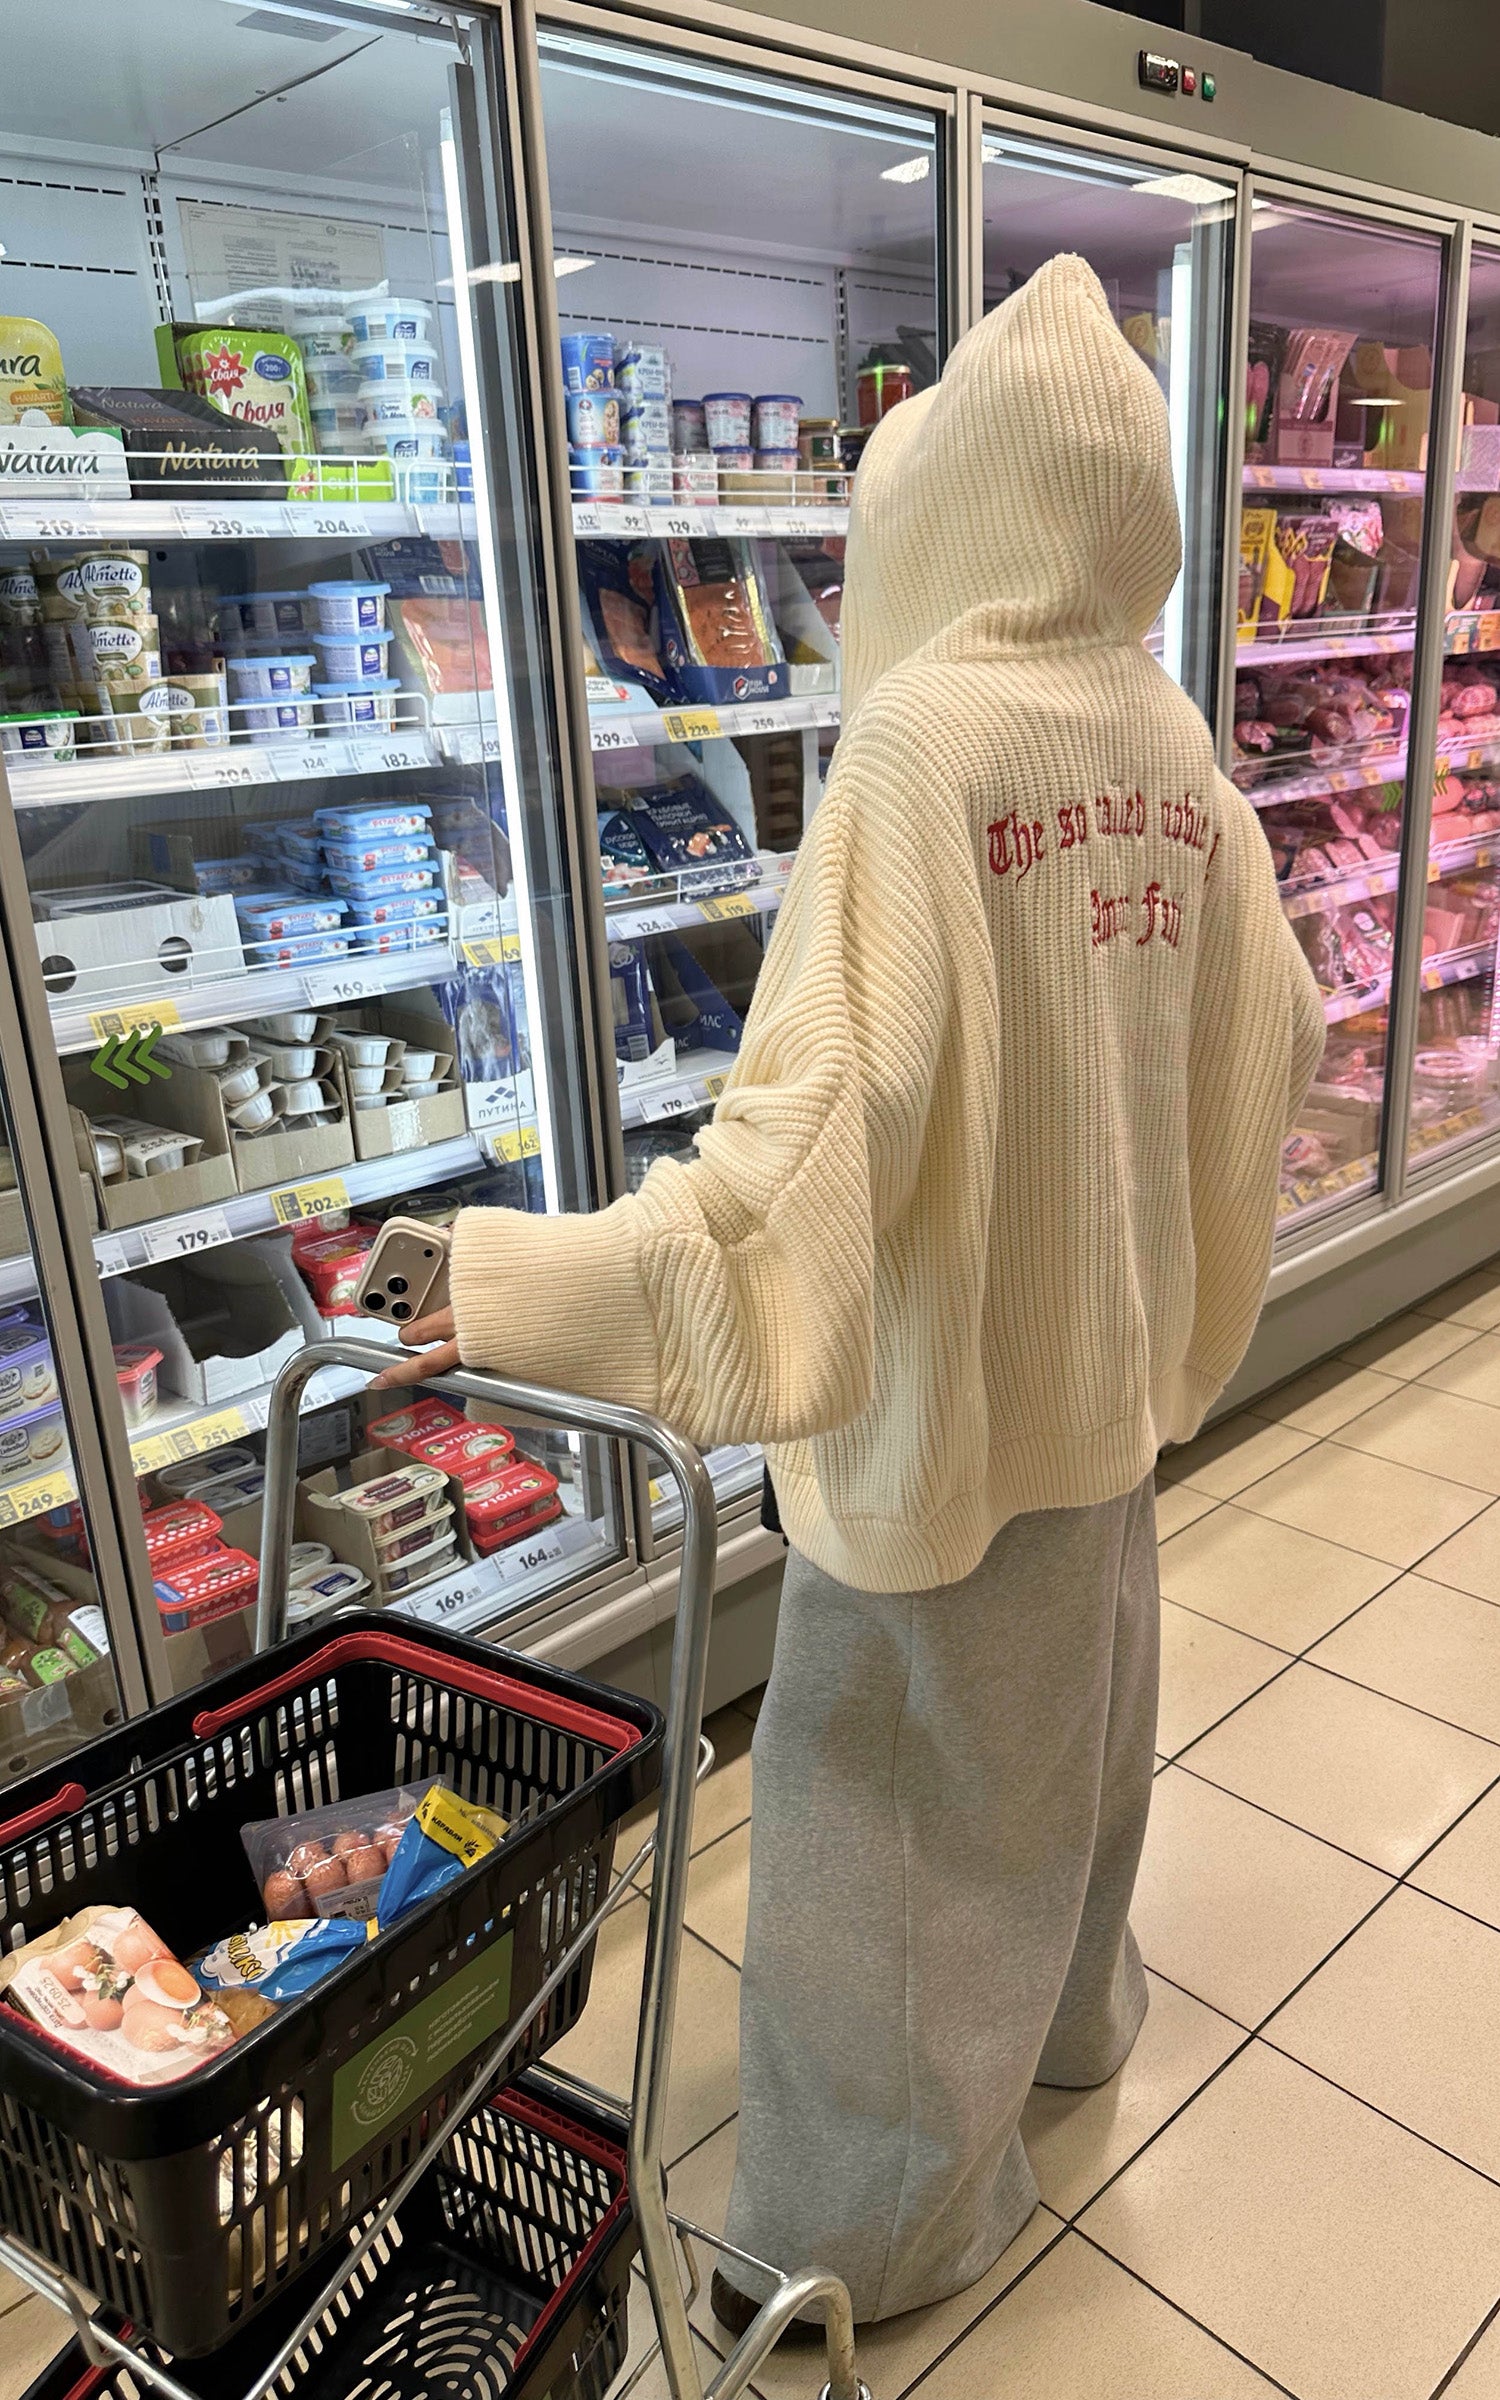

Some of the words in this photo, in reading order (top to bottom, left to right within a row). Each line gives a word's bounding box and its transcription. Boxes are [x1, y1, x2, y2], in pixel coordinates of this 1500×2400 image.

[100, 398, 164, 410] Natura
[160, 440, 260, 476] Natura
[208, 519, 243, 536] 239
[314, 519, 350, 535] 204
[667, 520, 690, 534] 129
[84, 564, 138, 583] Almette
[594, 733, 621, 748] 299
[381, 752, 412, 768] 182
[986, 809, 1045, 888] The
[636, 920, 660, 934] 124
[333, 979, 364, 997] 169
[478, 1100, 527, 1119] ПУТИНА
[661, 1099, 682, 1115] 179
[303, 1196, 334, 1215] 202
[176, 1229, 209, 1251] 179
[202, 1426, 232, 1448] 251
[393, 1425, 435, 1445] VIOLA
[444, 1427, 487, 1447] VIOLA
[18, 1493, 54, 1516] 249
[478, 1488, 522, 1510] VIOLA
[519, 1548, 548, 1571] 164
[435, 1589, 465, 1614] 169
